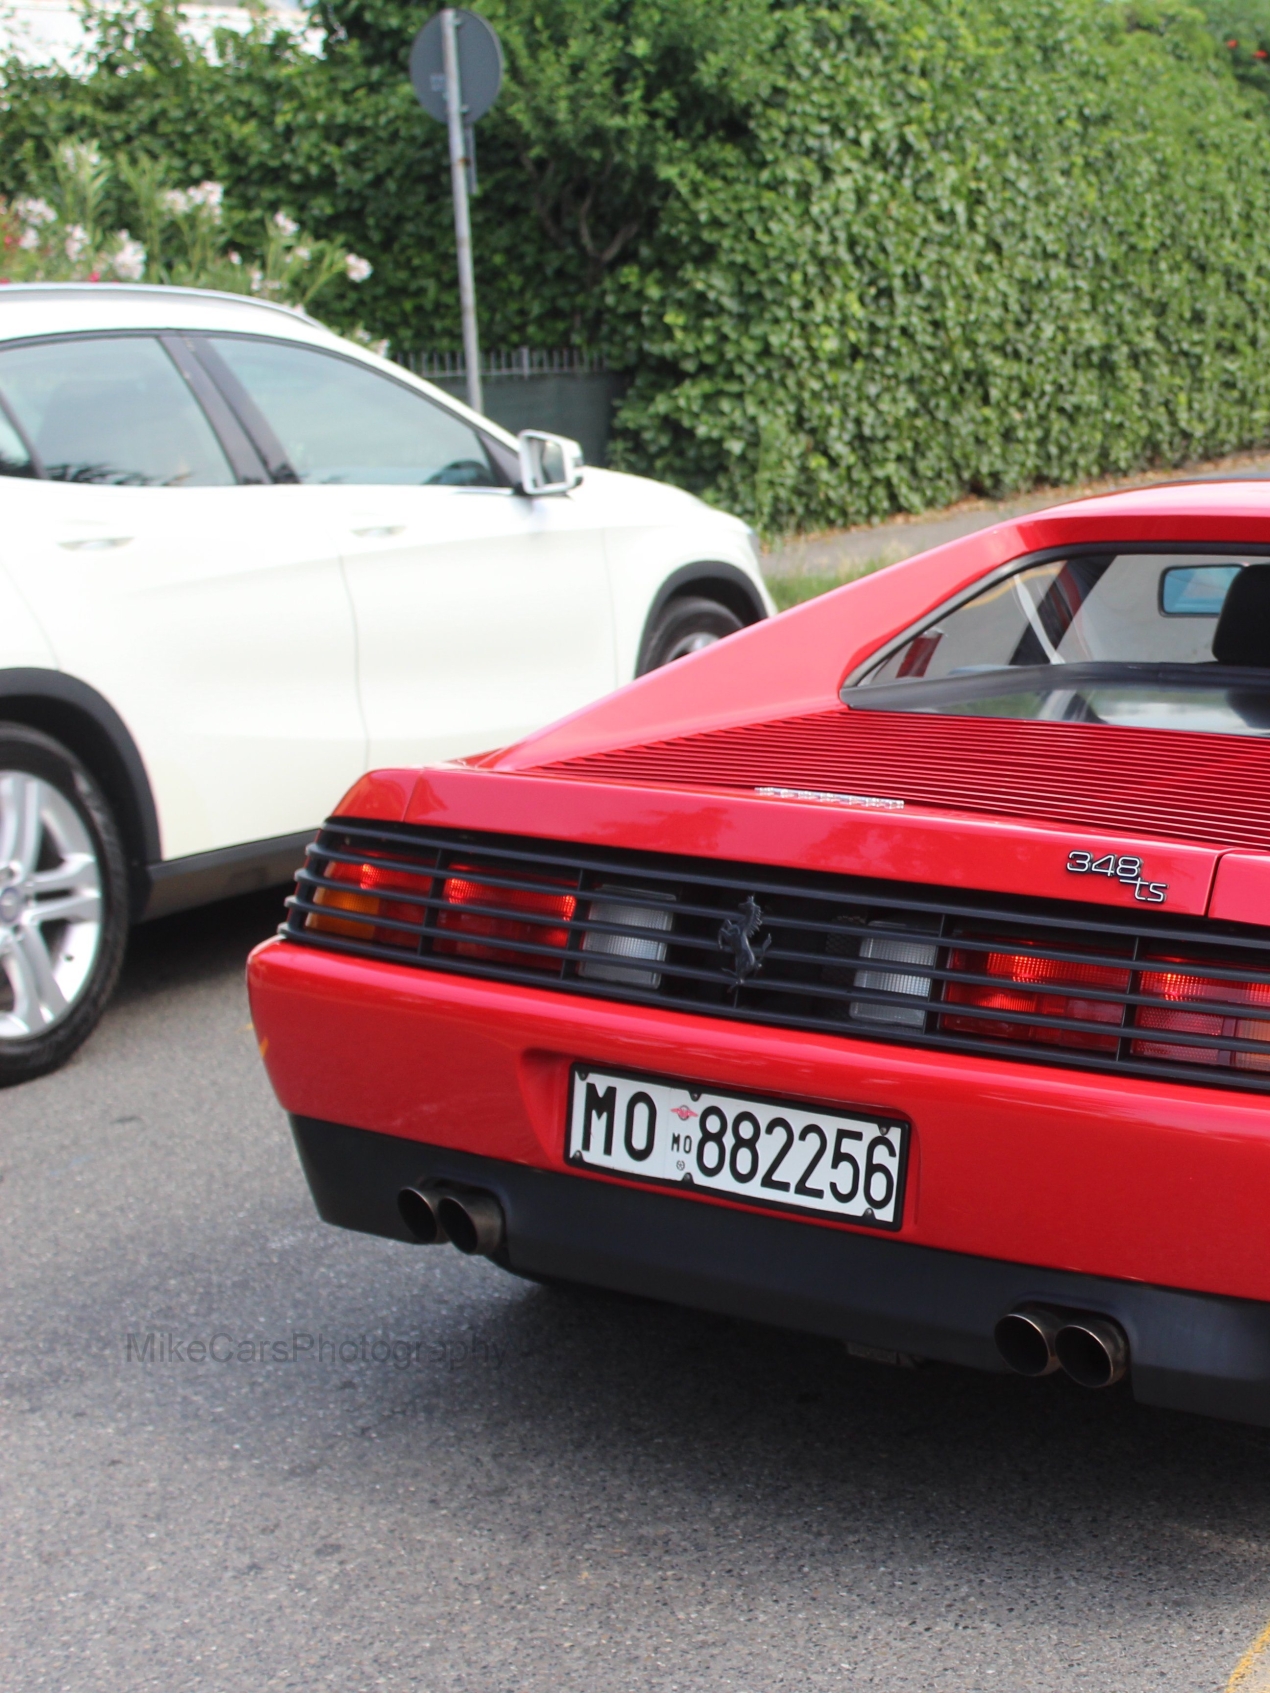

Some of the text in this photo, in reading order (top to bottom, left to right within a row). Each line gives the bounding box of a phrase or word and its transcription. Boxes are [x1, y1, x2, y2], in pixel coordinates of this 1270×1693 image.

[1066, 850, 1142, 877] 348
[581, 1082, 898, 1210] MO 882256
[670, 1132, 693, 1154] MO
